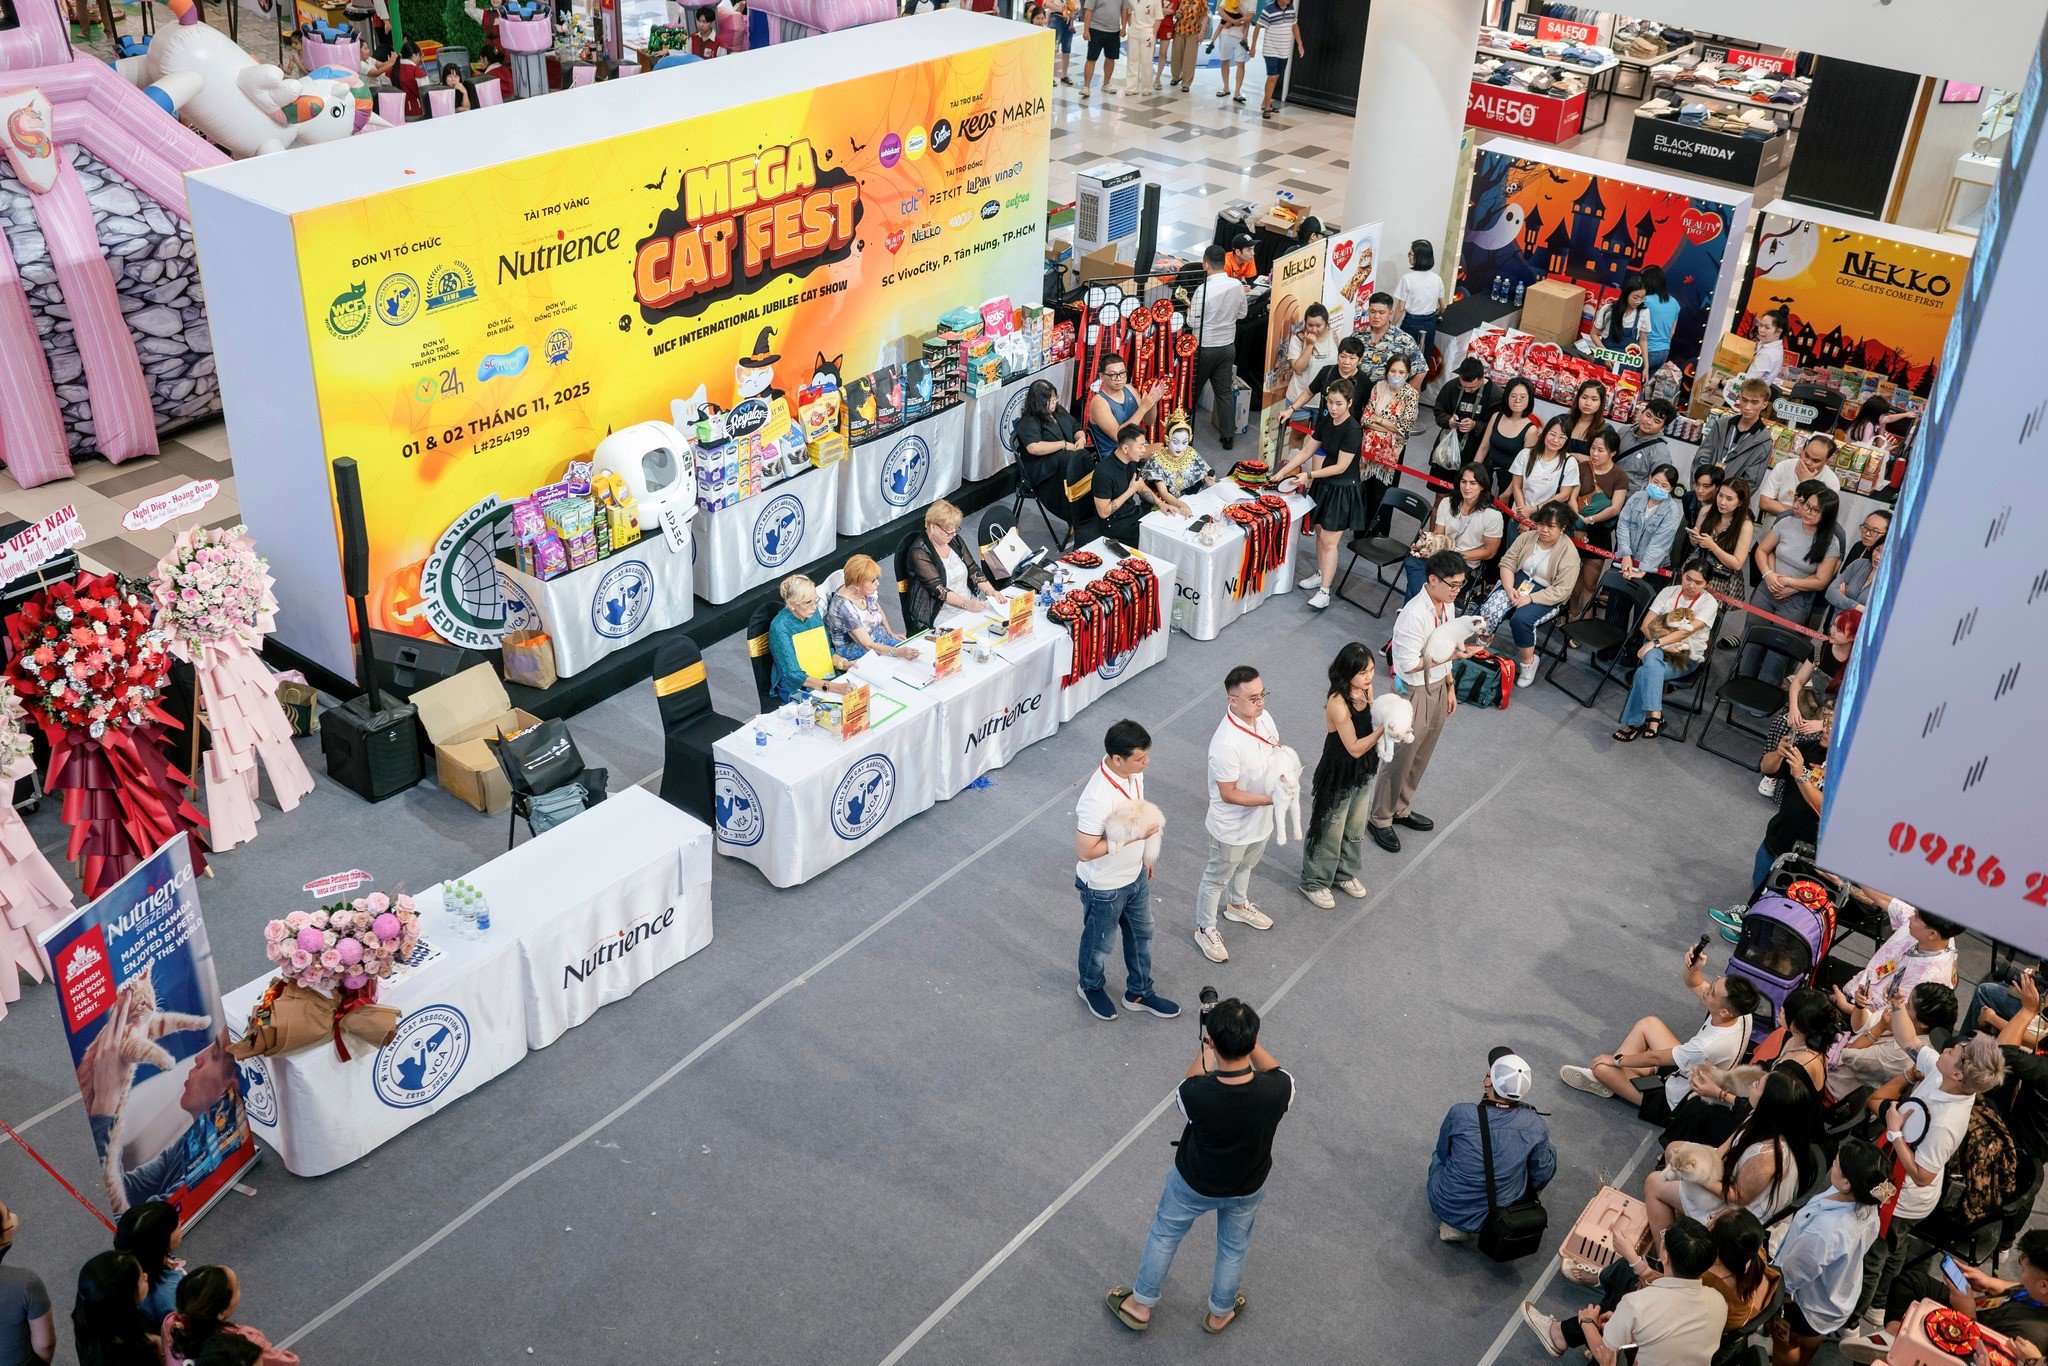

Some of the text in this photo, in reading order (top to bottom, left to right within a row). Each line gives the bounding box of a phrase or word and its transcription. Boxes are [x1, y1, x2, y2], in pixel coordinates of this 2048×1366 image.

[1548, 21, 1572, 36] SALE
[1571, 27, 1587, 40] 50
[1738, 54, 1765, 70] SALE
[1002, 97, 1045, 124] MARIA
[1505, 100, 1536, 127] 50
[1653, 145, 1693, 158] GIORDANO
[1654, 134, 1735, 161] BLACK FRIDAY
[685, 138, 816, 222] MEGA
[524, 196, 590, 221] TÀI TRỢ VÀNG
[911, 225, 942, 244] NEKKO
[1682, 217, 1718, 233] BEAUTY
[352, 237, 442, 268] ĐƠN VỊ TỔ CHỨC
[498, 227, 620, 285] Nutrience
[637, 182, 860, 307] CAT FEST
[882, 223, 1036, 287] SC VivoCity, P. Tân Hưng, TP.HCM
[1282, 255, 1317, 281] NEKKO
[1839, 251, 1951, 297] NEKKO
[331, 298, 363, 317] WCF
[1885, 289, 1913, 302] COME
[1913, 295, 1944, 309] FIRST!
[324, 317, 338, 338] WORLD
[653, 280, 848, 356] WCF INTERNATIONAL JUBILEE CAT SHOW
[551, 339, 567, 352] AVF
[1595, 348, 1642, 366] PETEMO
[402, 381, 591, 459] 01 & 02 THÁNG 11, 2025
[1777, 403, 1814, 416] PETEMO
[473, 425, 530, 455] L#254199
[908, 471, 918, 487] VCA
[45, 504, 76, 532] NAM
[665, 510, 685, 546] PETKIT
[763, 510, 772, 522] NAM
[426, 498, 497, 593] WORLD CAT
[780, 530, 792, 546] VCA
[603, 577, 613, 590] NAM
[613, 570, 625, 579] CAT
[627, 599, 639, 617] VCA
[508, 616, 525, 630] VCA
[964, 691, 1042, 755] Nutrience
[844, 775, 854, 790] NAM
[854, 766, 864, 776] CAT
[865, 794, 880, 814] VCA
[733, 815, 748, 828] VCA
[1888, 821, 2006, 888] 0986
[108, 863, 193, 947] Nutrience
[121, 900, 192, 963] MADE IN CANADA
[123, 911, 195, 975] ENJOYED BY PETS
[120, 917, 202, 994] AROUND THE WORLD
[563, 905, 675, 990] Nutrience
[70, 970, 101, 995] NOURISH
[72, 977, 107, 1004] THE BODY.
[74, 986, 107, 1012] FUEL THE
[76, 1001, 101, 1021] SPIRIT.
[381, 1013, 459, 1073] VIET NAM CAT ASSOCIATION
[429, 1051, 448, 1075] VCA
[405, 1072, 448, 1099] ESTD 2020
